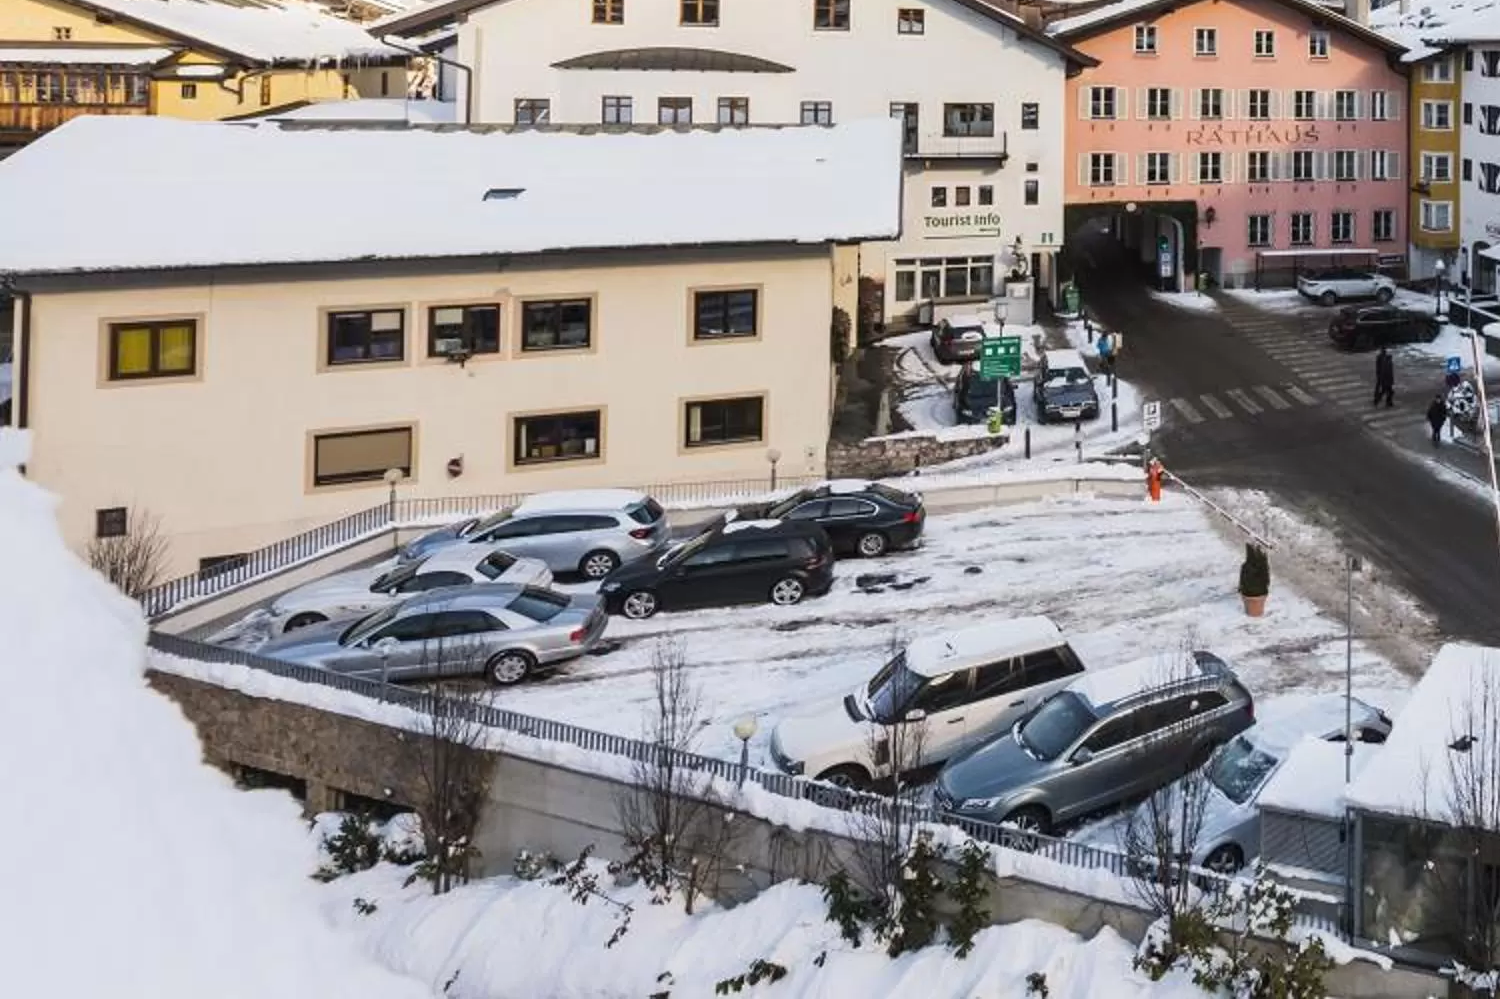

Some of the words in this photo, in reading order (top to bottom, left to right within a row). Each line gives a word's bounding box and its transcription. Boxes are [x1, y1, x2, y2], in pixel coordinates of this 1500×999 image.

[1186, 129, 1319, 145] RATHAUS
[923, 214, 971, 228] Tourist
[974, 212, 1001, 226] Info
